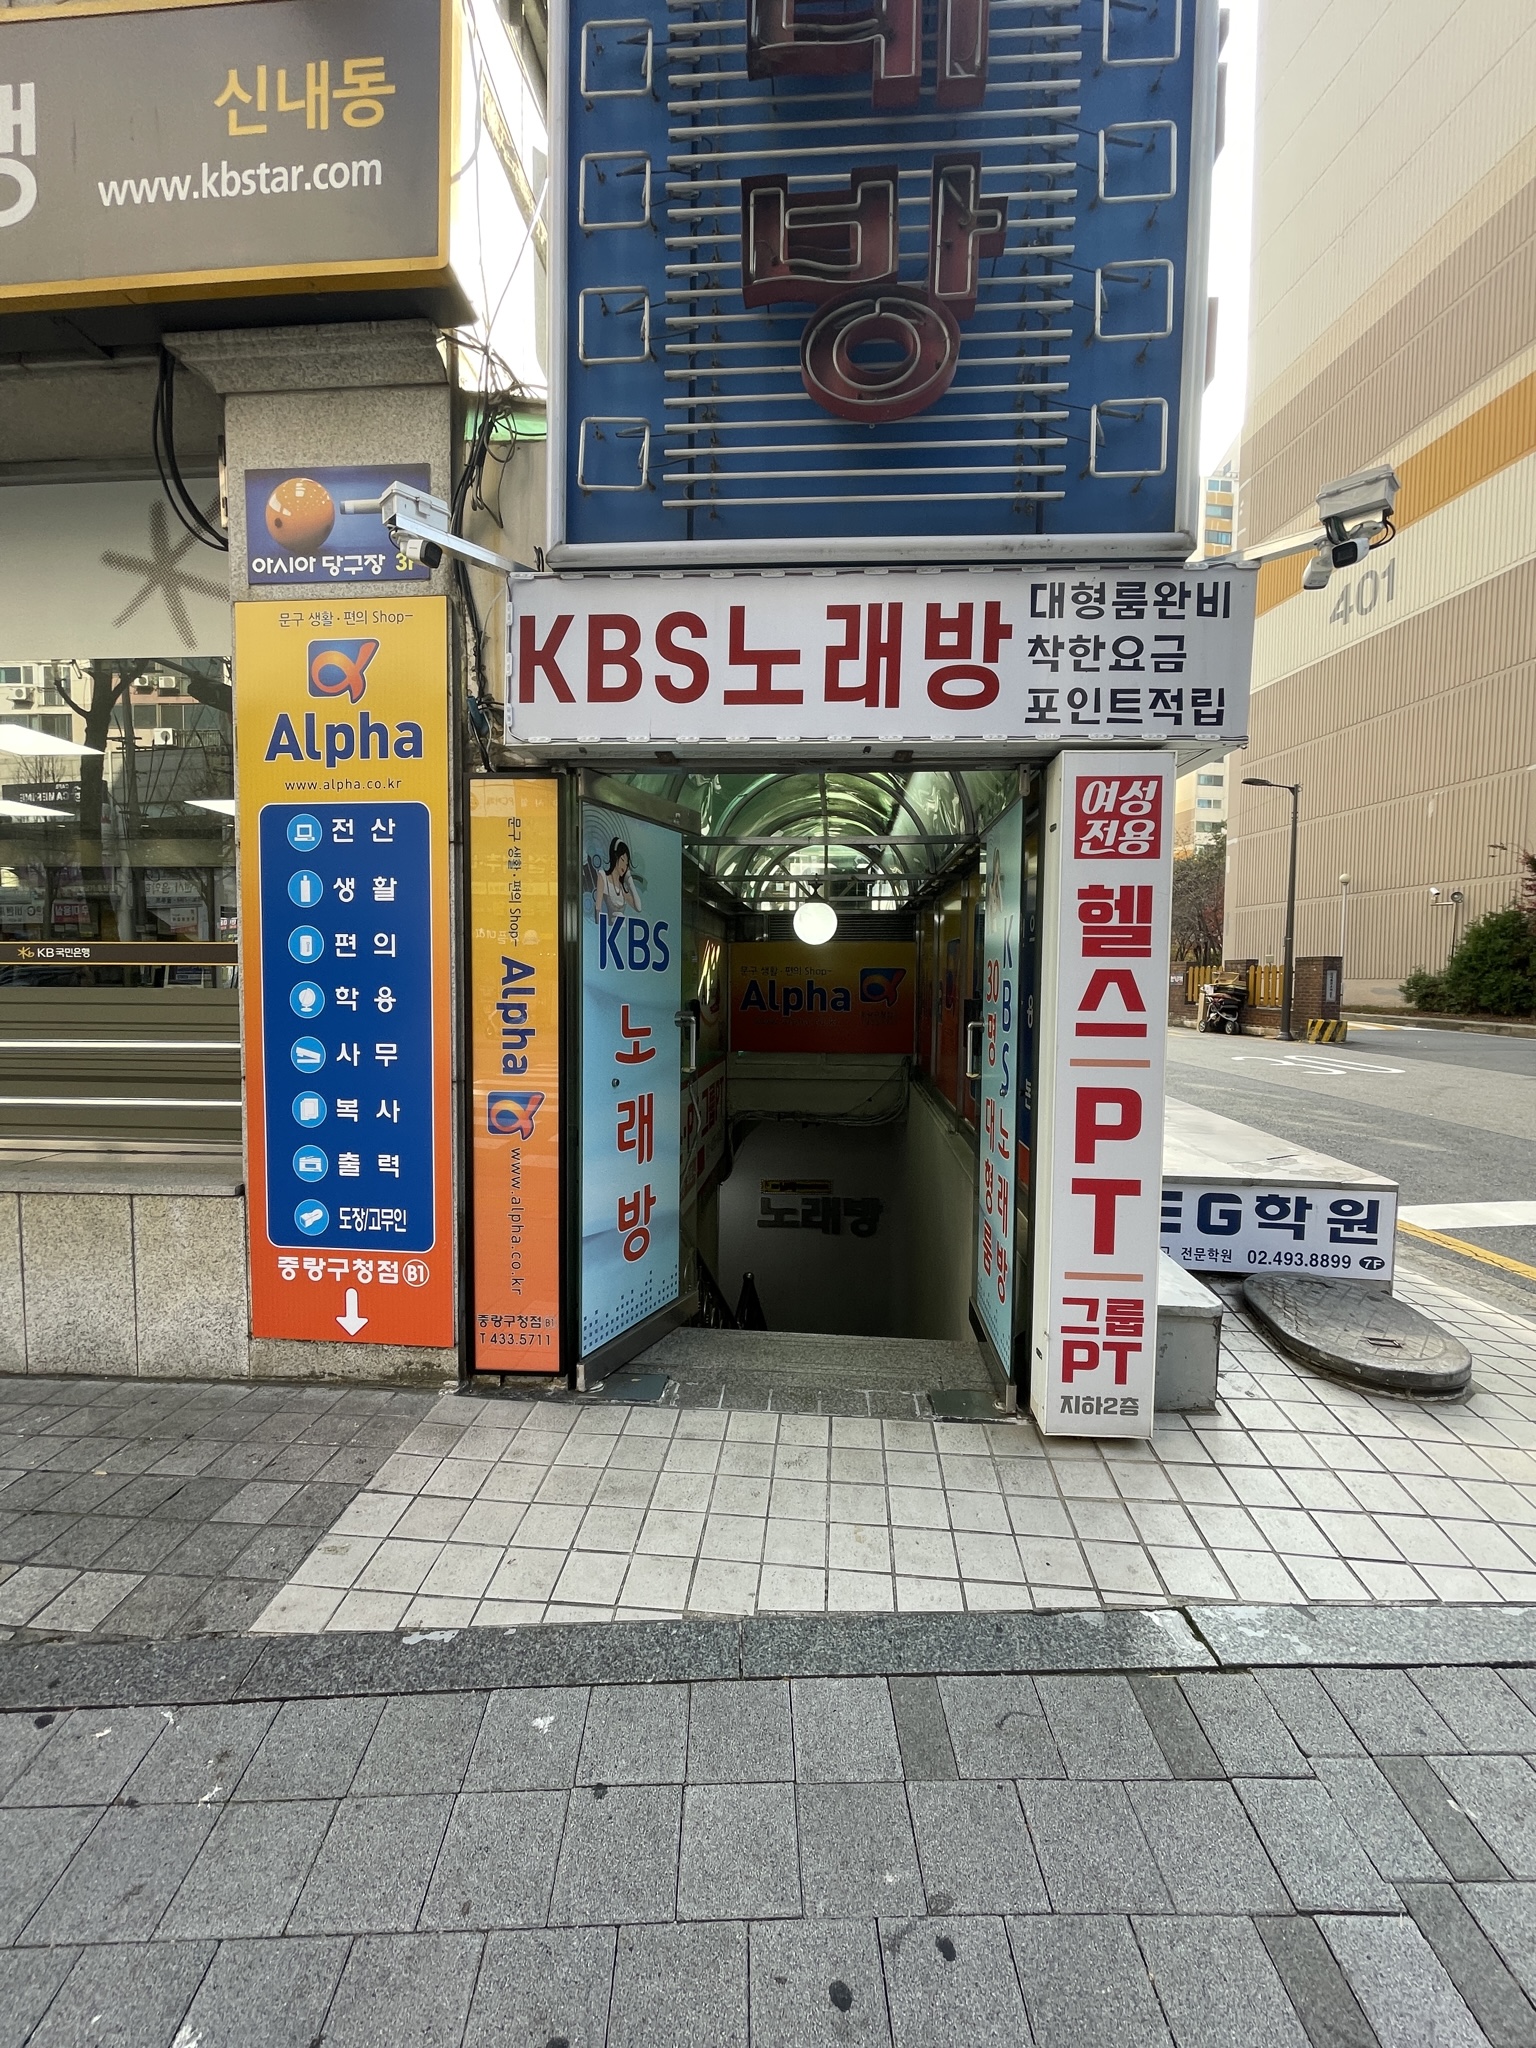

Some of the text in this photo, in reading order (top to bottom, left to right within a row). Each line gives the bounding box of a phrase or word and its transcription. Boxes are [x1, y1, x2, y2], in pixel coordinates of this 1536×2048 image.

[213, 56, 396, 136] 신내동
[98, 158, 383, 206] www.kbstar.com
[252, 556, 316, 574] 아시아
[322, 554, 386, 577] 당구장
[1030, 580, 1231, 620] 대형룸완비
[1329, 557, 1397, 626] 401
[279, 612, 304, 628] 문구
[518, 600, 1013, 710] KBS노래방
[1027, 634, 1187, 673] 착한요금
[1024, 687, 1226, 726] 포인트적립
[264, 711, 424, 769] Alpha
[285, 778, 402, 792] www.alpha.co.kr
[1081, 779, 1158, 816] 여성
[508, 817, 521, 841] 문구
[1079, 819, 1156, 855] 전용
[37, 948, 90, 958] KB국민은행
[599, 913, 670, 972] KBS
[1075, 885, 1153, 1038] 헬스
[496, 955, 536, 1076] Alpha
[739, 979, 851, 1017] Alpha
[615, 1004, 656, 1263] 노래방
[339, 1207, 407, 1232] 도장/고무인
[507, 1148, 524, 1295] www.alpha.co.kr
[277, 1256, 425, 1285] 중랑구청점 B1
[1181, 1247, 1233, 1264] 전문학원
[1247, 1249, 1351, 1269] 02.493.8899
[1363, 1259, 1382, 1269] 7F
[478, 1315, 541, 1328] 중랑구청점
[1060, 1297, 1145, 1338] 그룹
[490, 1333, 550, 1345] 433.5711
[1061, 1339, 1143, 1385] PT
[1060, 1395, 1139, 1417] 지하2층
